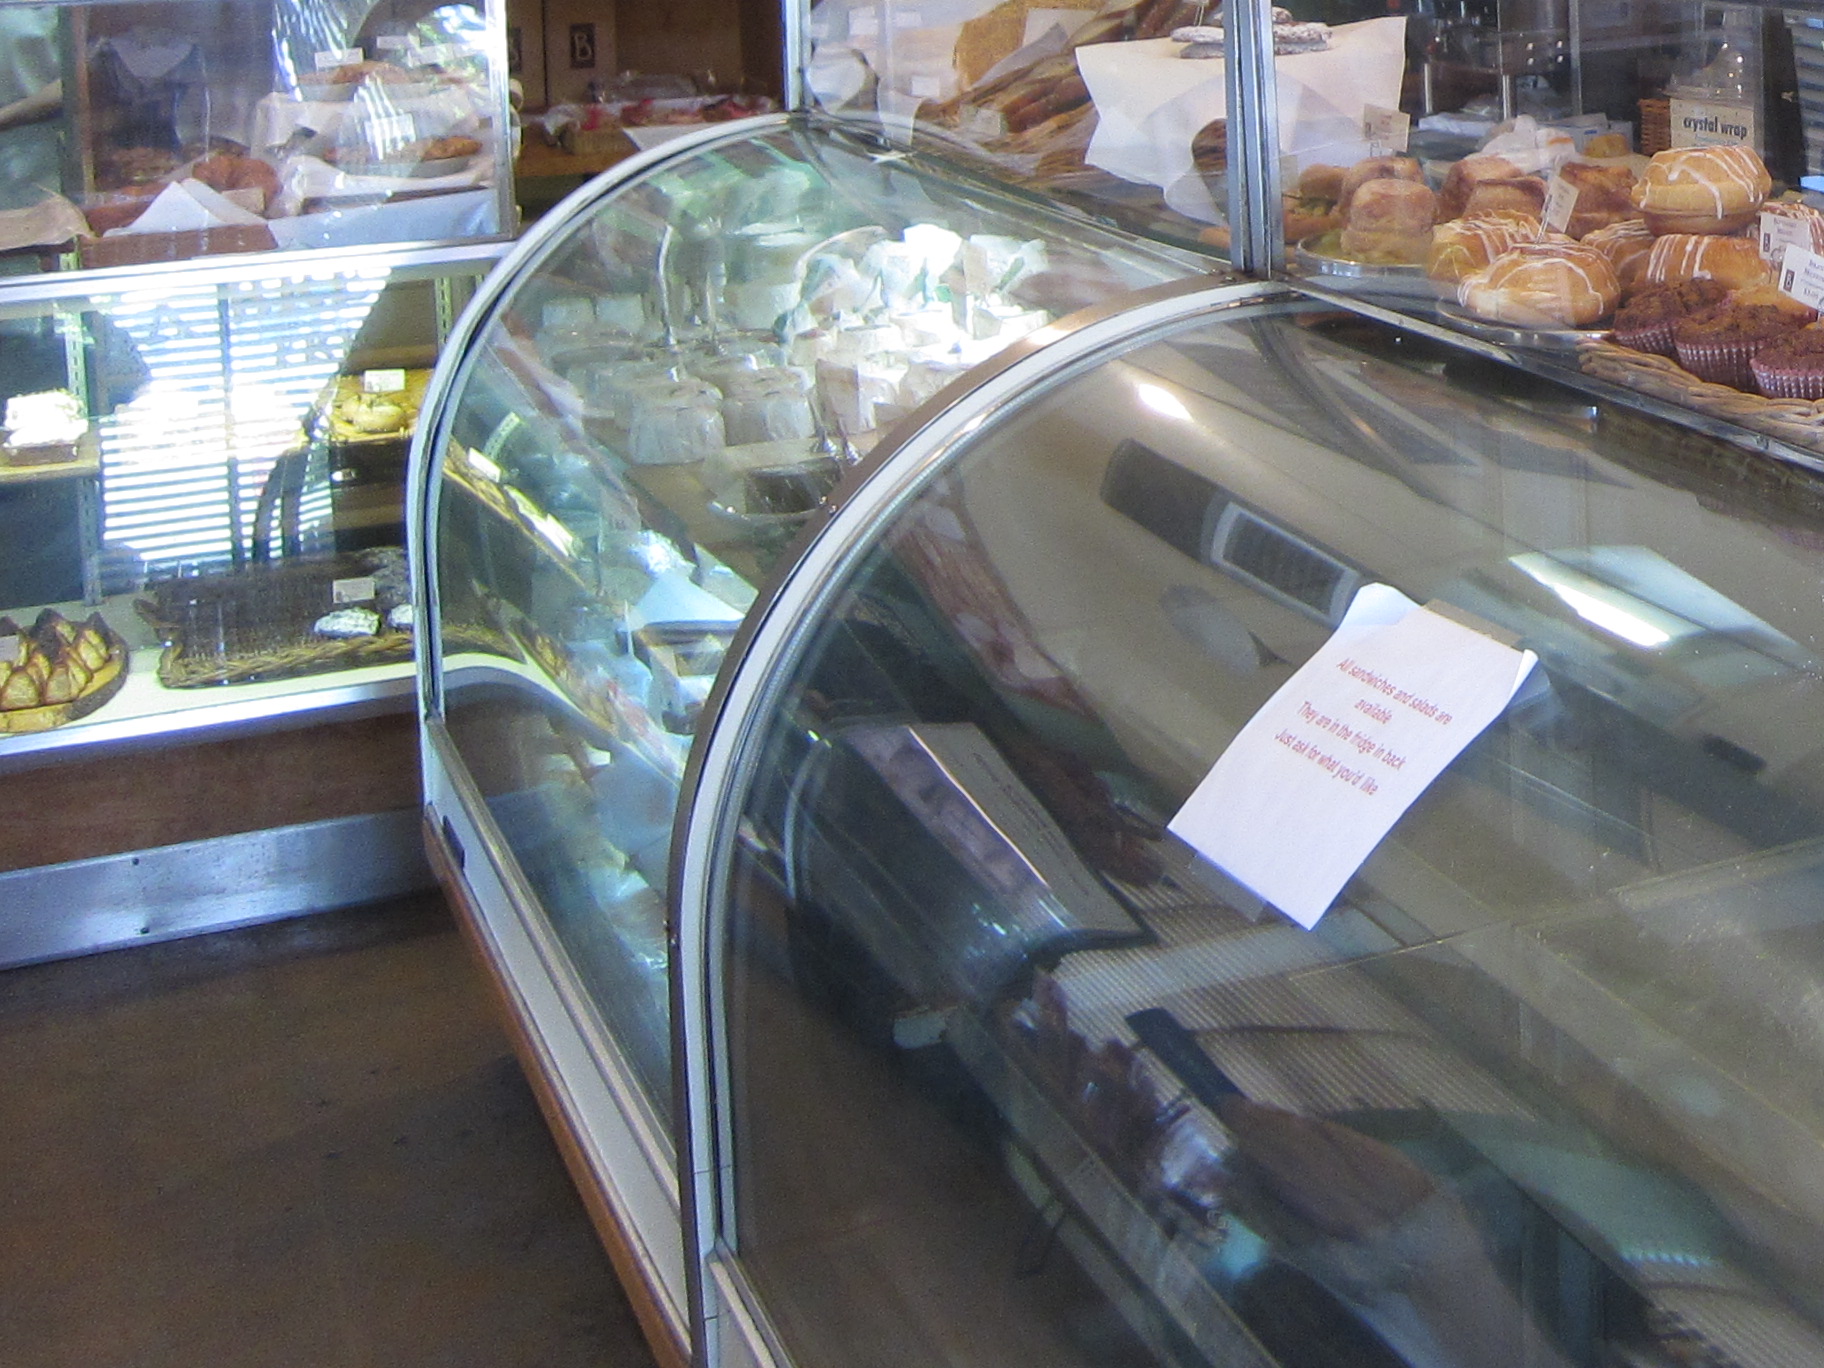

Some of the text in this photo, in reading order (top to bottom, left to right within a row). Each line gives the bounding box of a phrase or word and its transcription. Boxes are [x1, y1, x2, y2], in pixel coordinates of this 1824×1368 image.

[1683, 116, 1747, 141] crystal wrap
[1336, 658, 1453, 726] All sandwiches and salads are
[1353, 698, 1393, 725] available
[1274, 728, 1380, 796] Just ask for what you'd like
[1297, 700, 1407, 771] They are in the fridge in back
